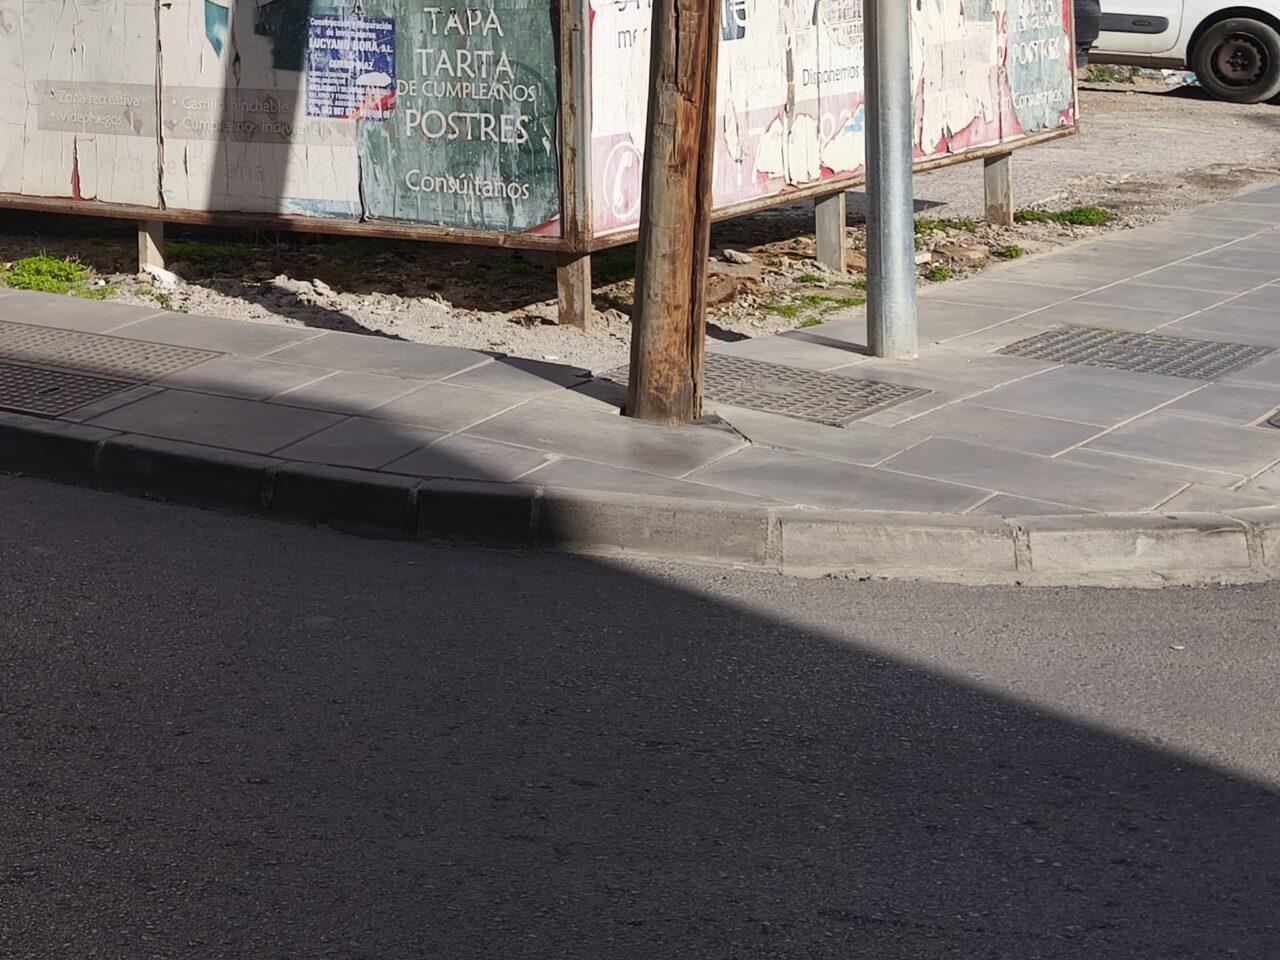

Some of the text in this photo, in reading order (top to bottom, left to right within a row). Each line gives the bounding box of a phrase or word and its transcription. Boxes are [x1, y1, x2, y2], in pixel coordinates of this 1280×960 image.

[423, 6, 504, 37] TAPA
[414, 47, 516, 80] TARTA
[395, 79, 537, 102] DE CUMPLEAÑOS
[405, 108, 530, 144] POSTRES
